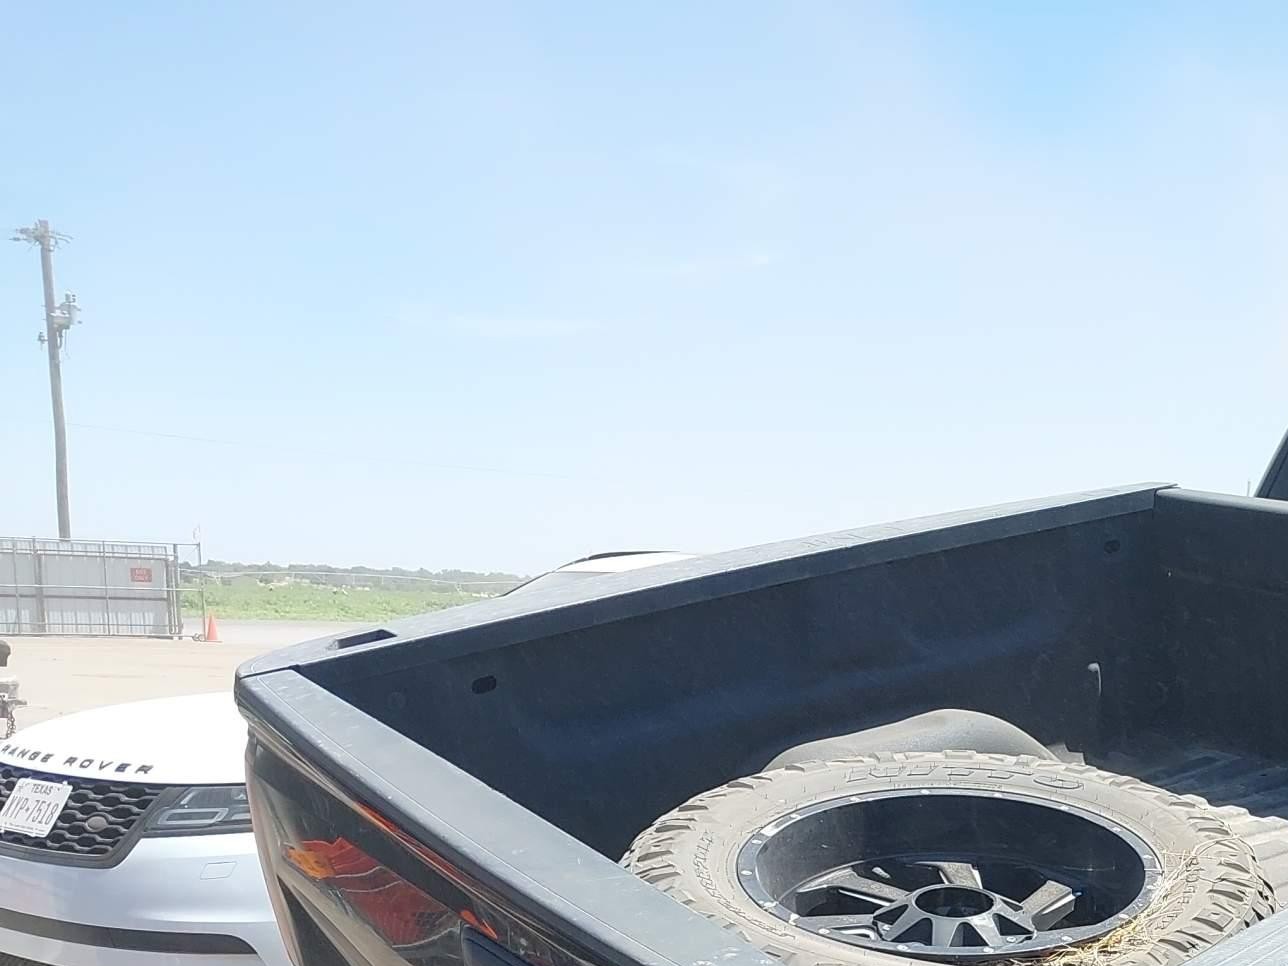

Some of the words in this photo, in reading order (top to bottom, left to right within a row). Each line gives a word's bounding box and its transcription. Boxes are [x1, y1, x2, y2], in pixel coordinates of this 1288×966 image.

[1, 744, 54, 763] RANGE
[63, 756, 154, 774] ROVER
[31, 783, 54, 796] TEXAS
